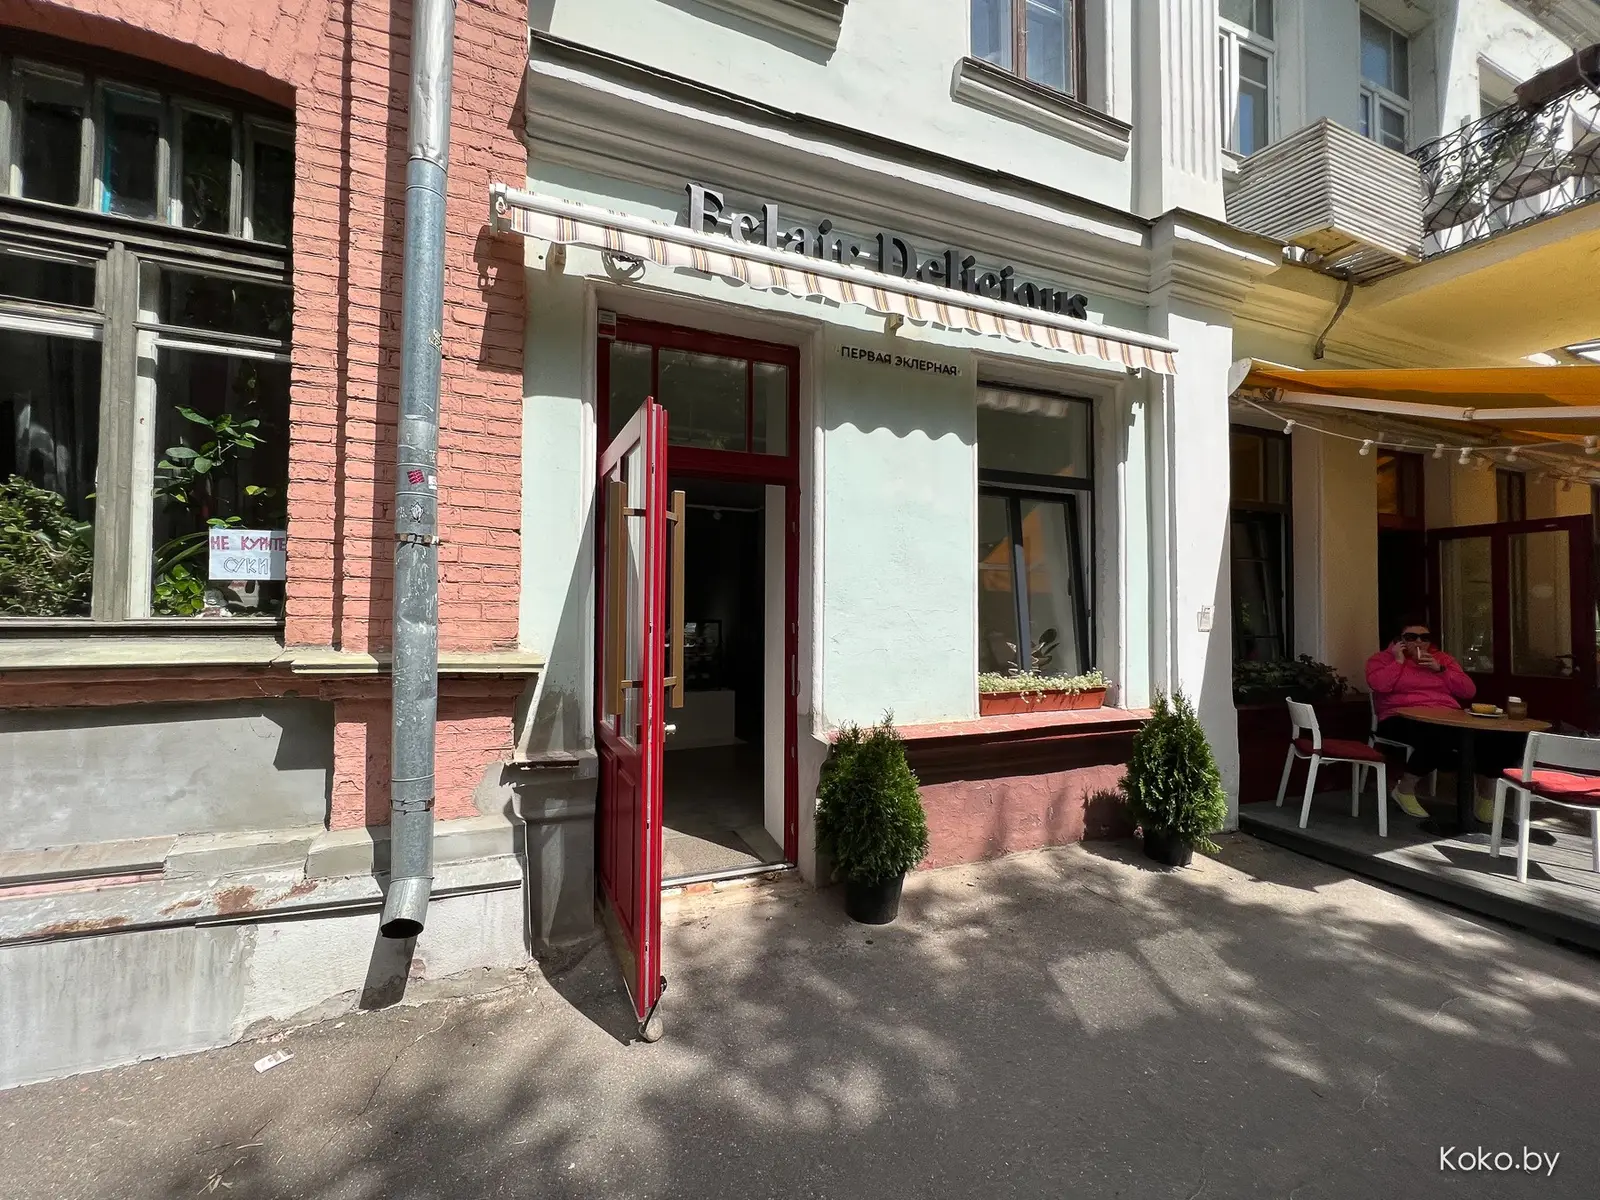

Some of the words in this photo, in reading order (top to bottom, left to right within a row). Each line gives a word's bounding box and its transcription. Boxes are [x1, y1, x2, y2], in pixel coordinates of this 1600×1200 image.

[685, 182, 861, 264] Eclair
[875, 232, 1089, 320] Delicious
[841, 346, 892, 365] ПЕРВАЯ
[895, 355, 957, 376] ЭКЛЕРНАЯ
[210, 535, 230, 551] НЕ
[240, 535, 286, 552] КУРИТЕ
[223, 556, 269, 575] СУКИ
